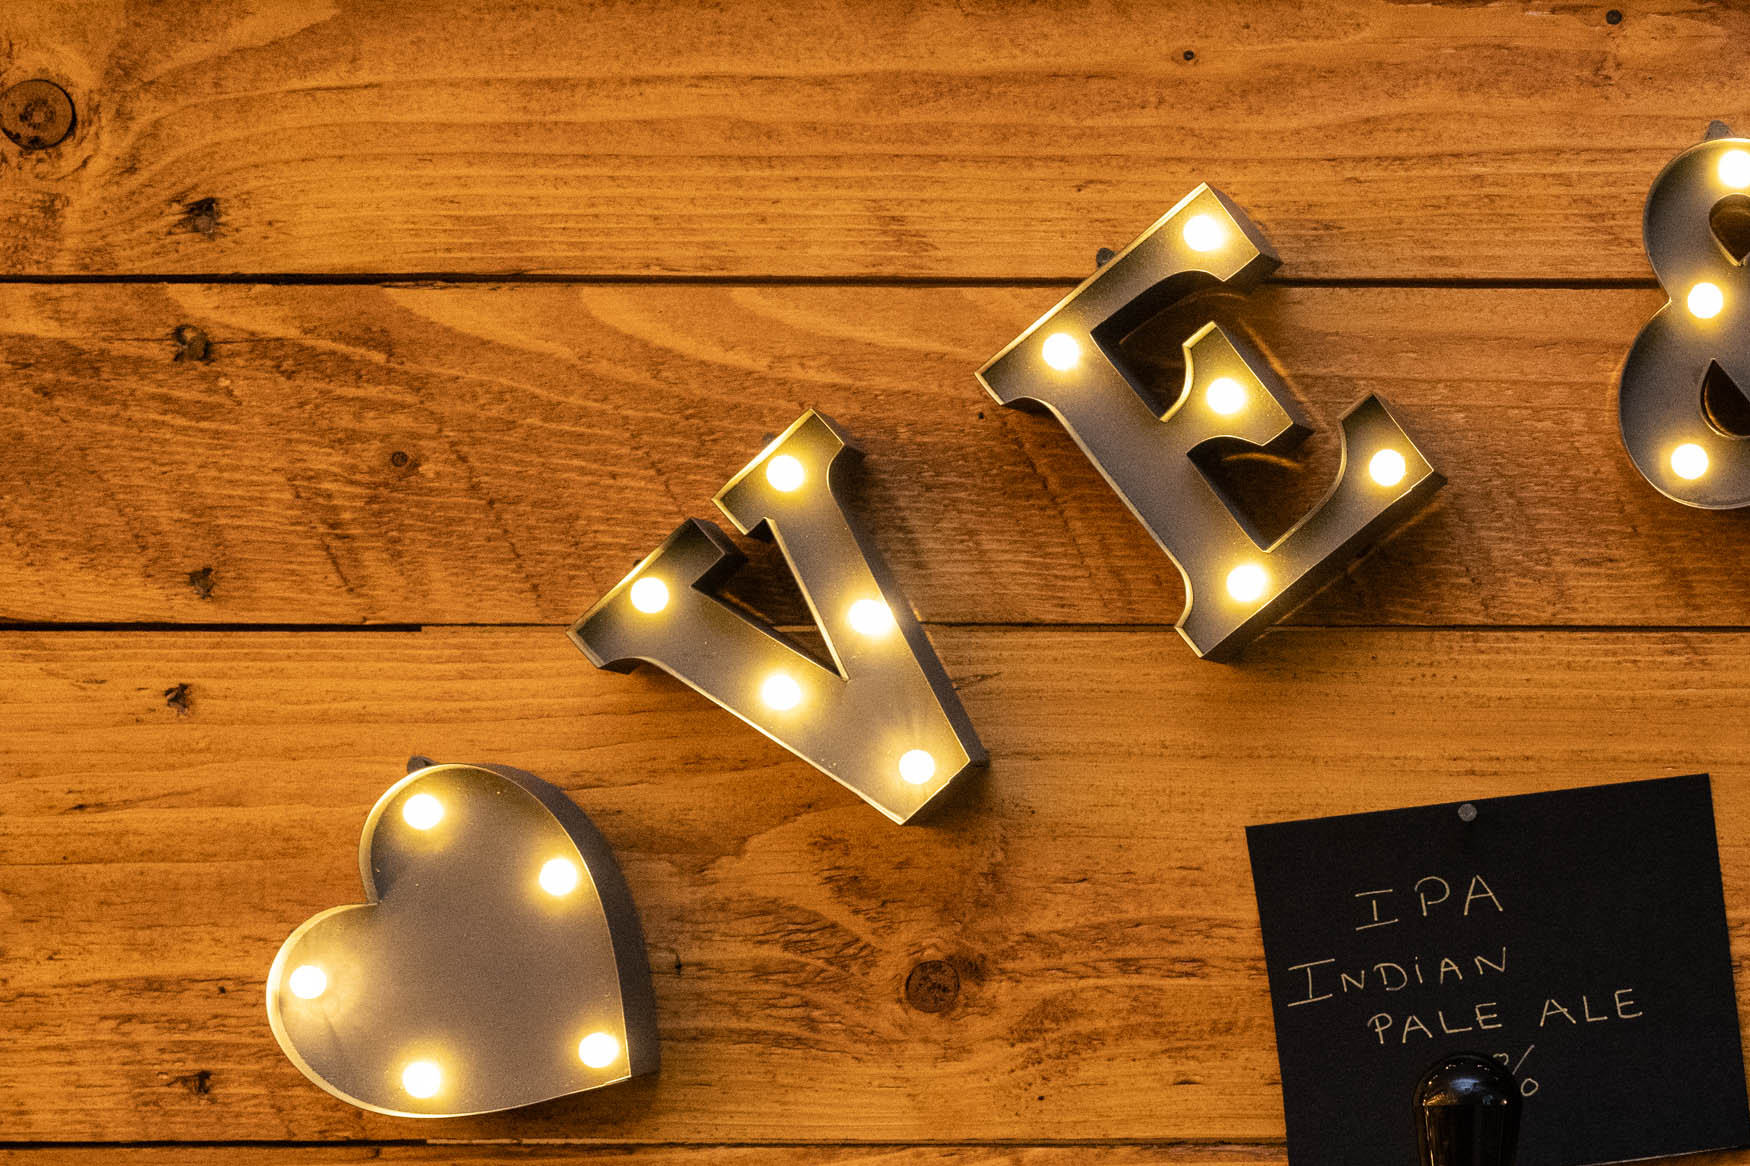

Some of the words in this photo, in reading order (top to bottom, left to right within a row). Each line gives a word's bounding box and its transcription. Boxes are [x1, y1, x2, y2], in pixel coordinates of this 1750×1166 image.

[1354, 874, 1504, 931] IPA
[1367, 1002, 1503, 1044] PALE
[1539, 988, 1643, 1028] ALE
